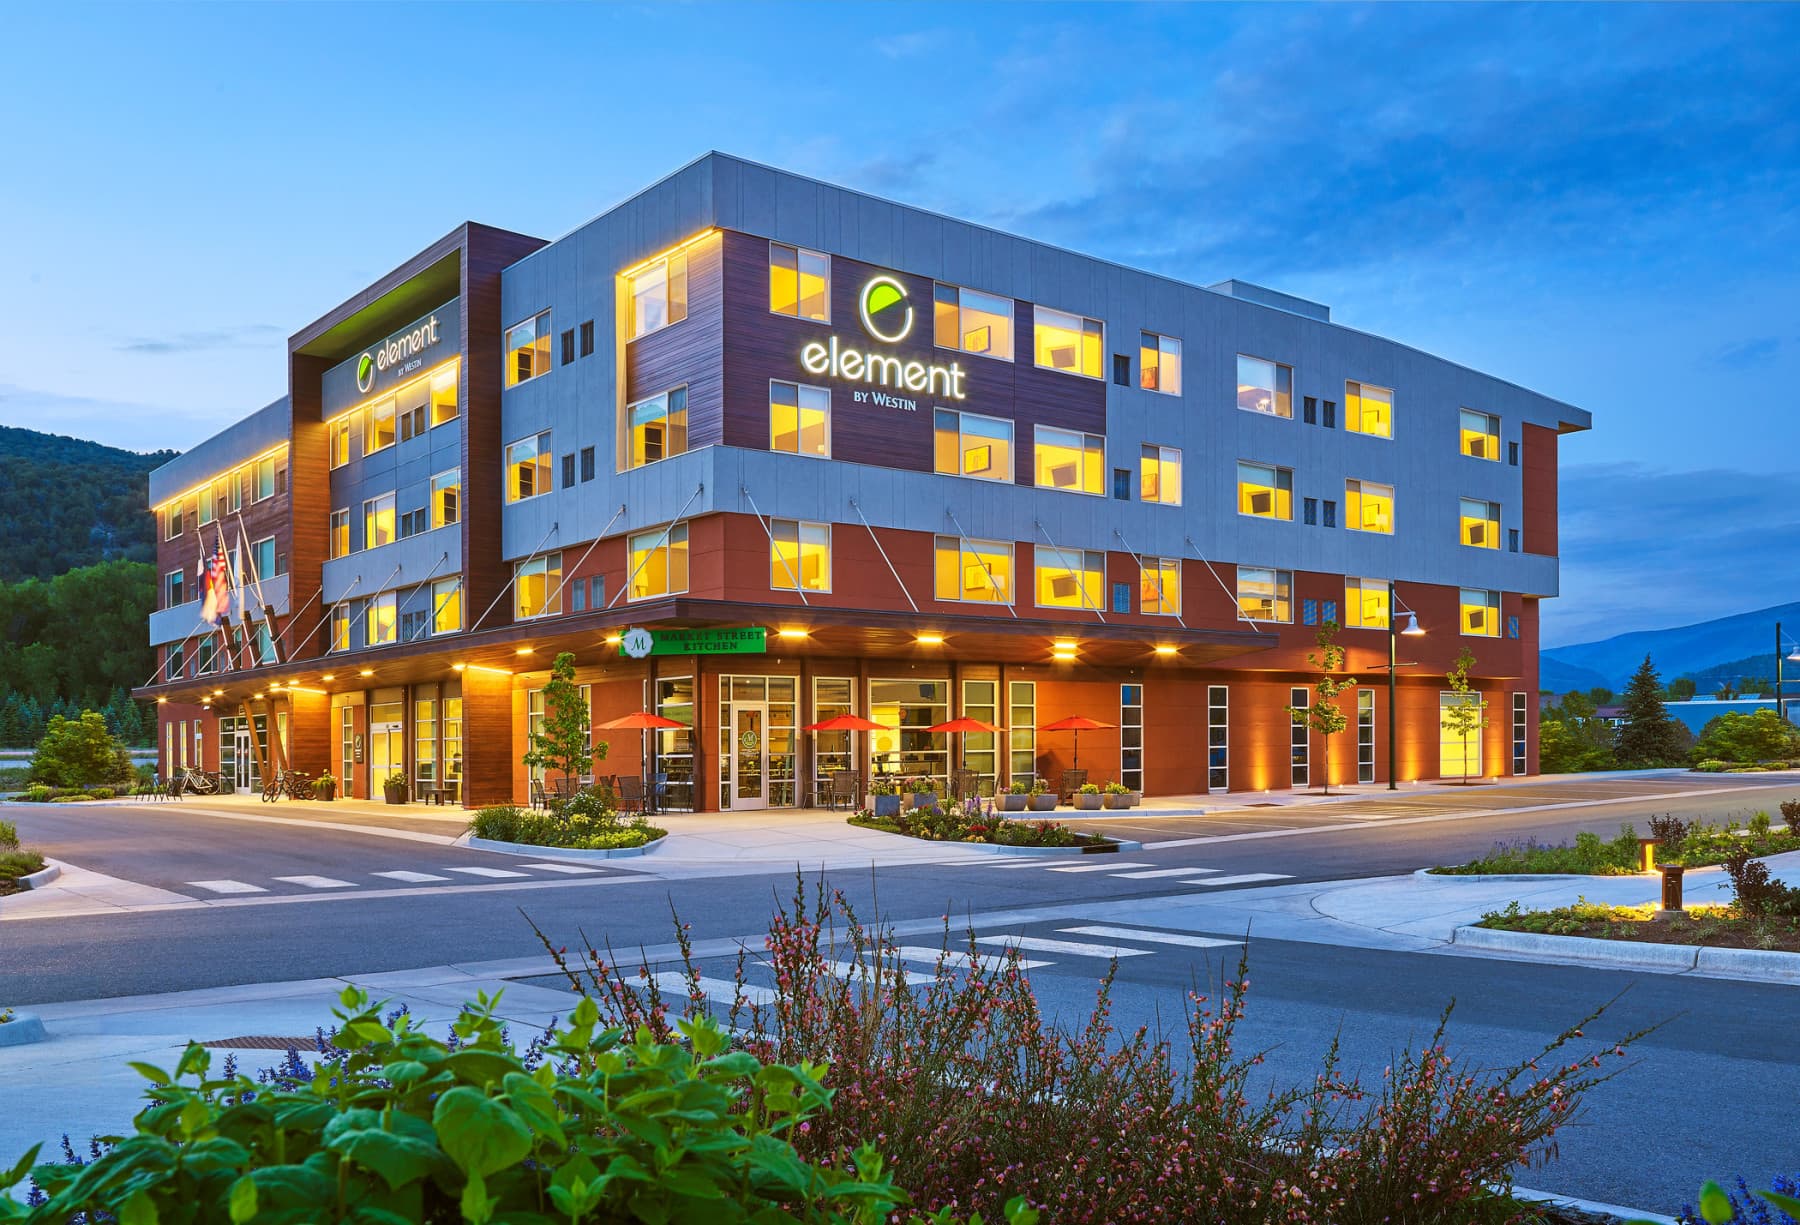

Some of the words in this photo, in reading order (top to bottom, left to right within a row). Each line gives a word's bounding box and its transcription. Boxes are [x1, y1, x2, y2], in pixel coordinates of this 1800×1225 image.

[377, 315, 438, 370] element
[801, 336, 966, 399] element
[853, 391, 868, 403] BY
[871, 391, 917, 412] WESTIN
[631, 636, 646, 651] M
[717, 631, 762, 641] STREET
[683, 641, 738, 652] KITCHEN
